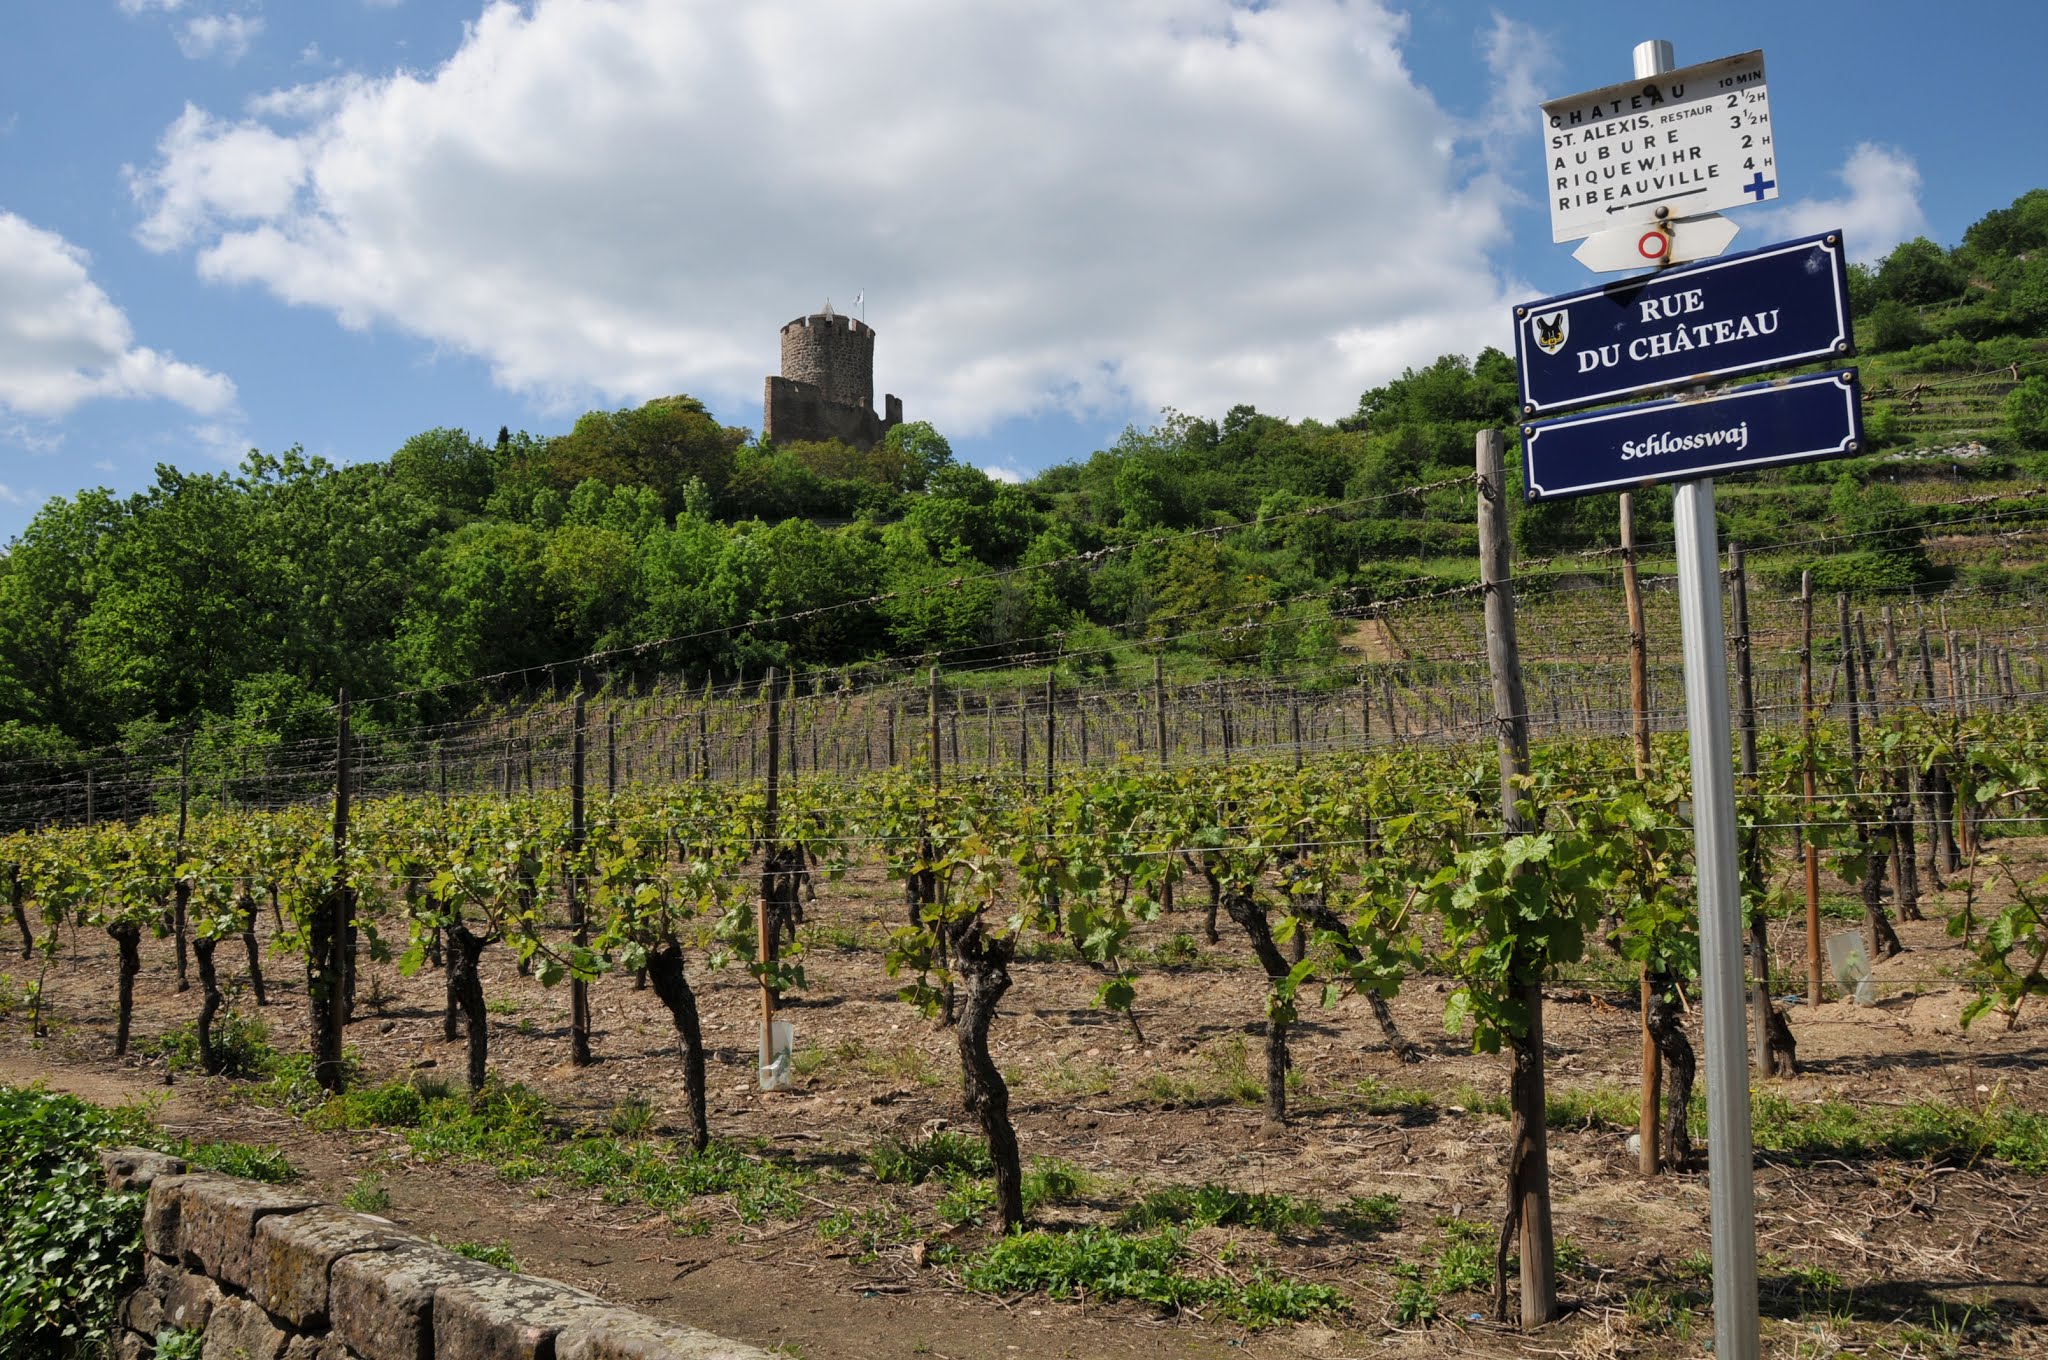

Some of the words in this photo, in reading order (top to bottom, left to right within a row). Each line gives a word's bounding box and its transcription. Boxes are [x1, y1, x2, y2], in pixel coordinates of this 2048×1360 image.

[1550, 84, 1685, 129] CHATEAU
[1718, 78, 1733, 89] 10
[1736, 70, 1762, 85] MIN
[1552, 133, 1576, 149] ST.
[1660, 105, 1713, 124] RESTAUR
[1554, 130, 1679, 170] AUBURE
[1557, 146, 1702, 190] RIQUEWIHR
[1741, 134, 1753, 148] 2
[1762, 136, 1770, 145] H
[1559, 164, 1719, 210] RIBEAUVILLE
[1743, 157, 1755, 170] 4
[1764, 157, 1772, 166] H
[1639, 289, 1705, 323] RUE
[1577, 343, 1621, 373] DU
[1628, 310, 1780, 361] CHÂTEAU
[1620, 422, 1748, 461] Schlosswaj
